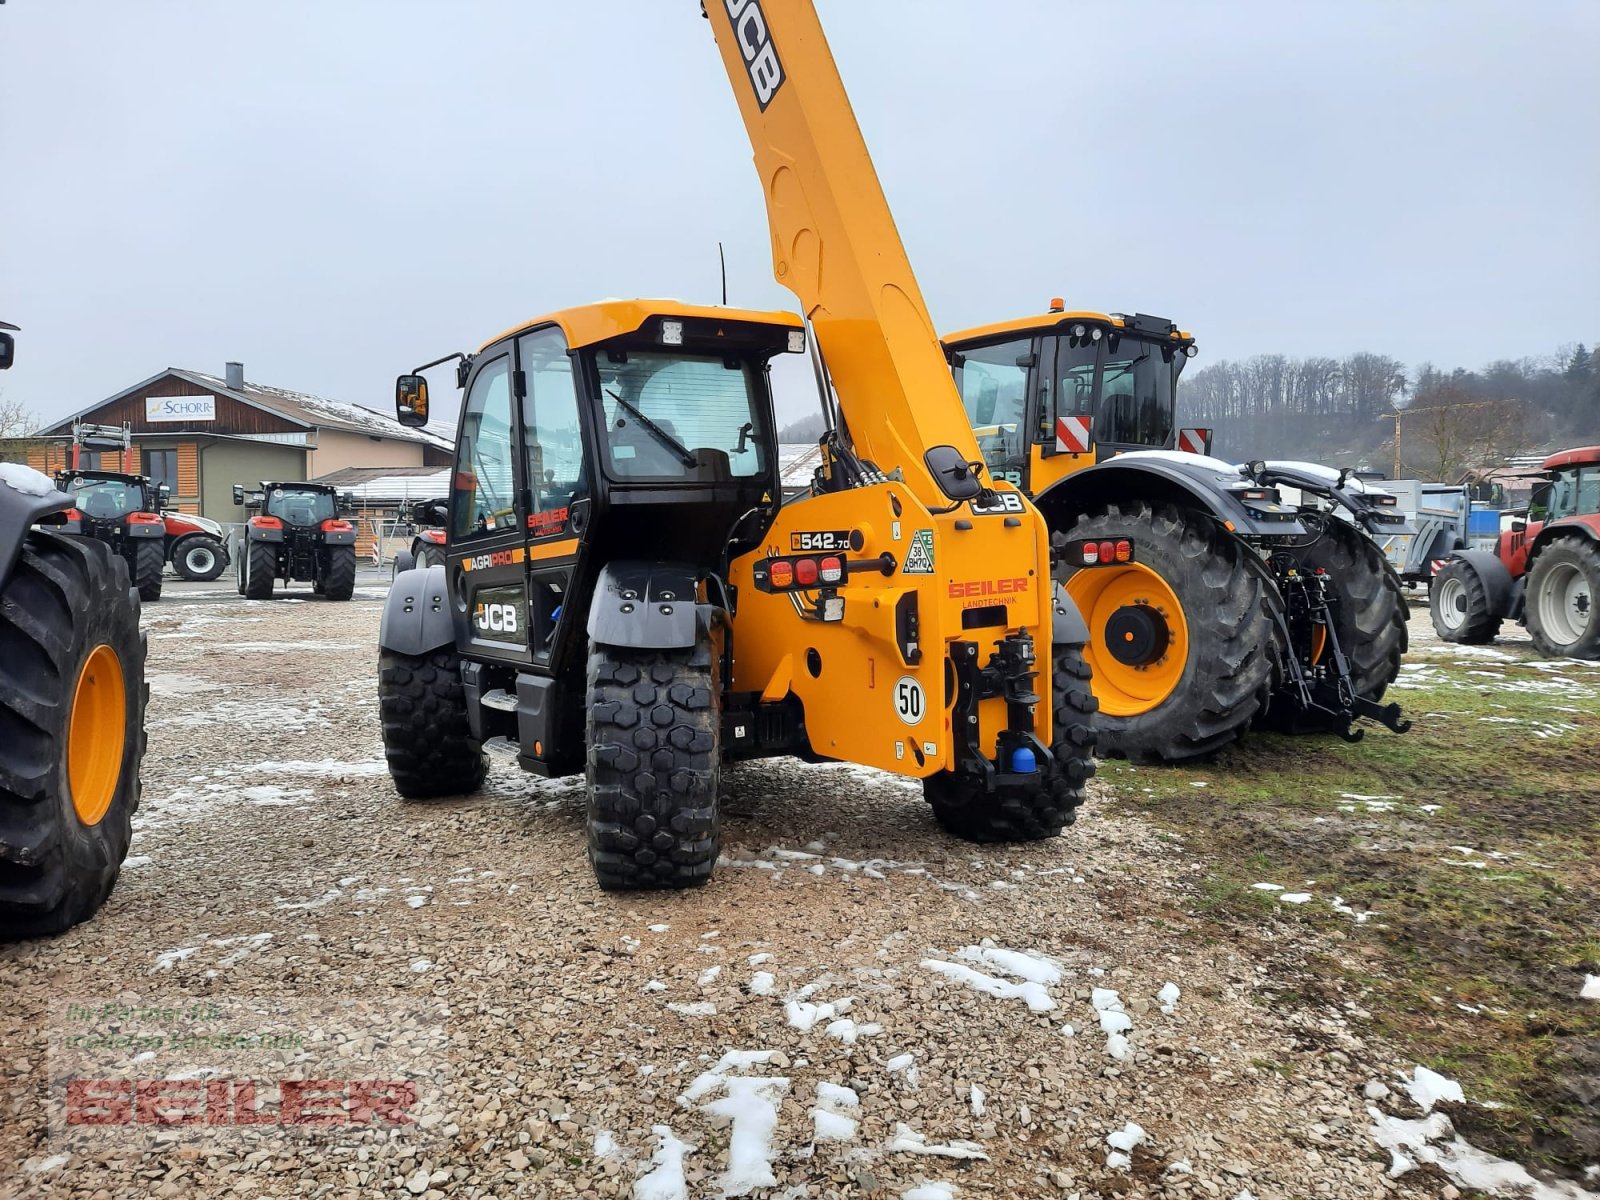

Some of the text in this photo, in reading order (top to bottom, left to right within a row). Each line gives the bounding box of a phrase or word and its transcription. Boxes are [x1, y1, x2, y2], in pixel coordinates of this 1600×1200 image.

[165, 400, 211, 414] SCHORR
[527, 507, 569, 528] SEILER
[471, 550, 513, 571] AGRIPRO
[913, 546, 922, 557] 38
[948, 577, 1028, 599] SEILER
[962, 596, 1017, 609] LANDTECHNIK
[478, 603, 517, 633] JCB
[899, 683, 920, 717] 50
